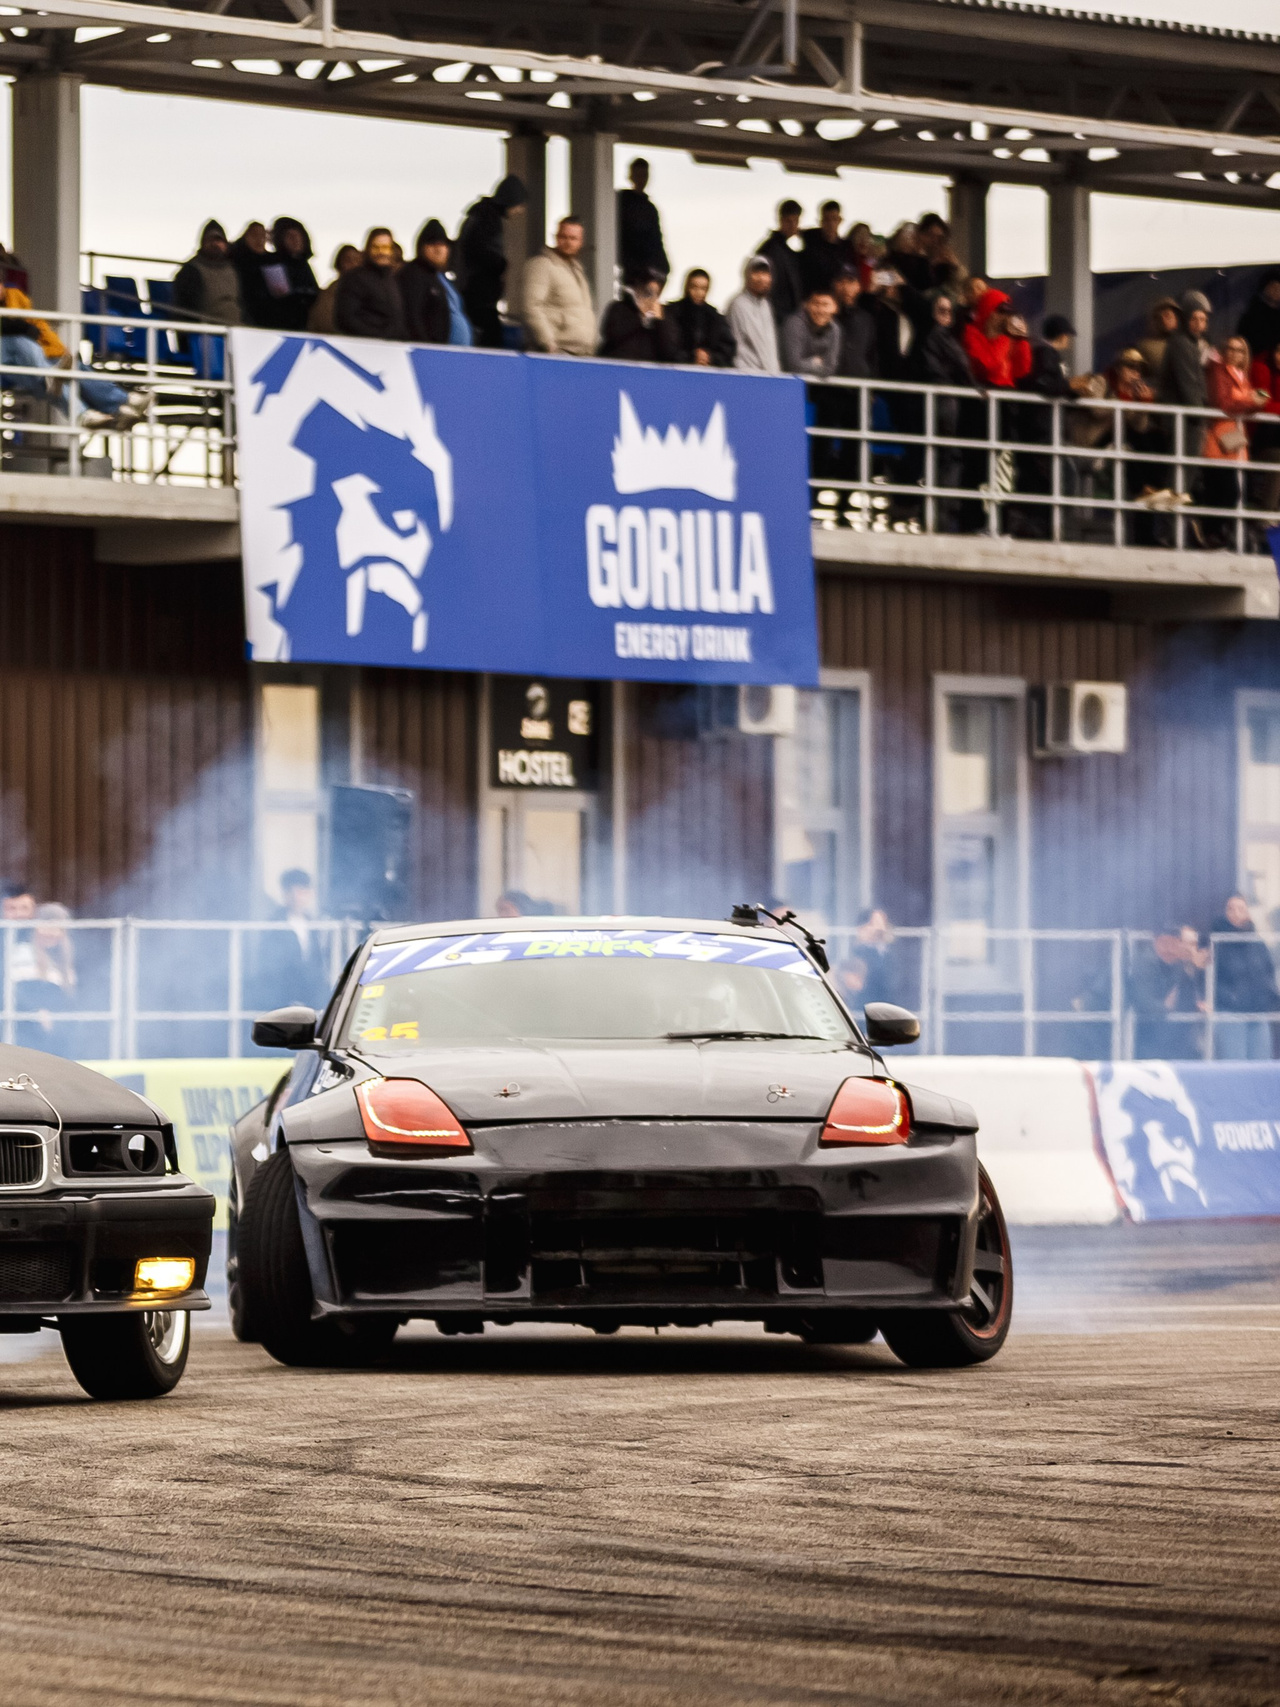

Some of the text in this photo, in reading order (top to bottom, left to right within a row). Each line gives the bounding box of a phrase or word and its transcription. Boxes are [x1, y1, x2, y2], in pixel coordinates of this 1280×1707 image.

[585, 504, 775, 614] GORILLA
[615, 622, 750, 663] ENERGY DRINK
[498, 749, 576, 786] HOSTEL
[523, 940, 655, 957] DRIFT
[1213, 1121, 1275, 1151] POWER
